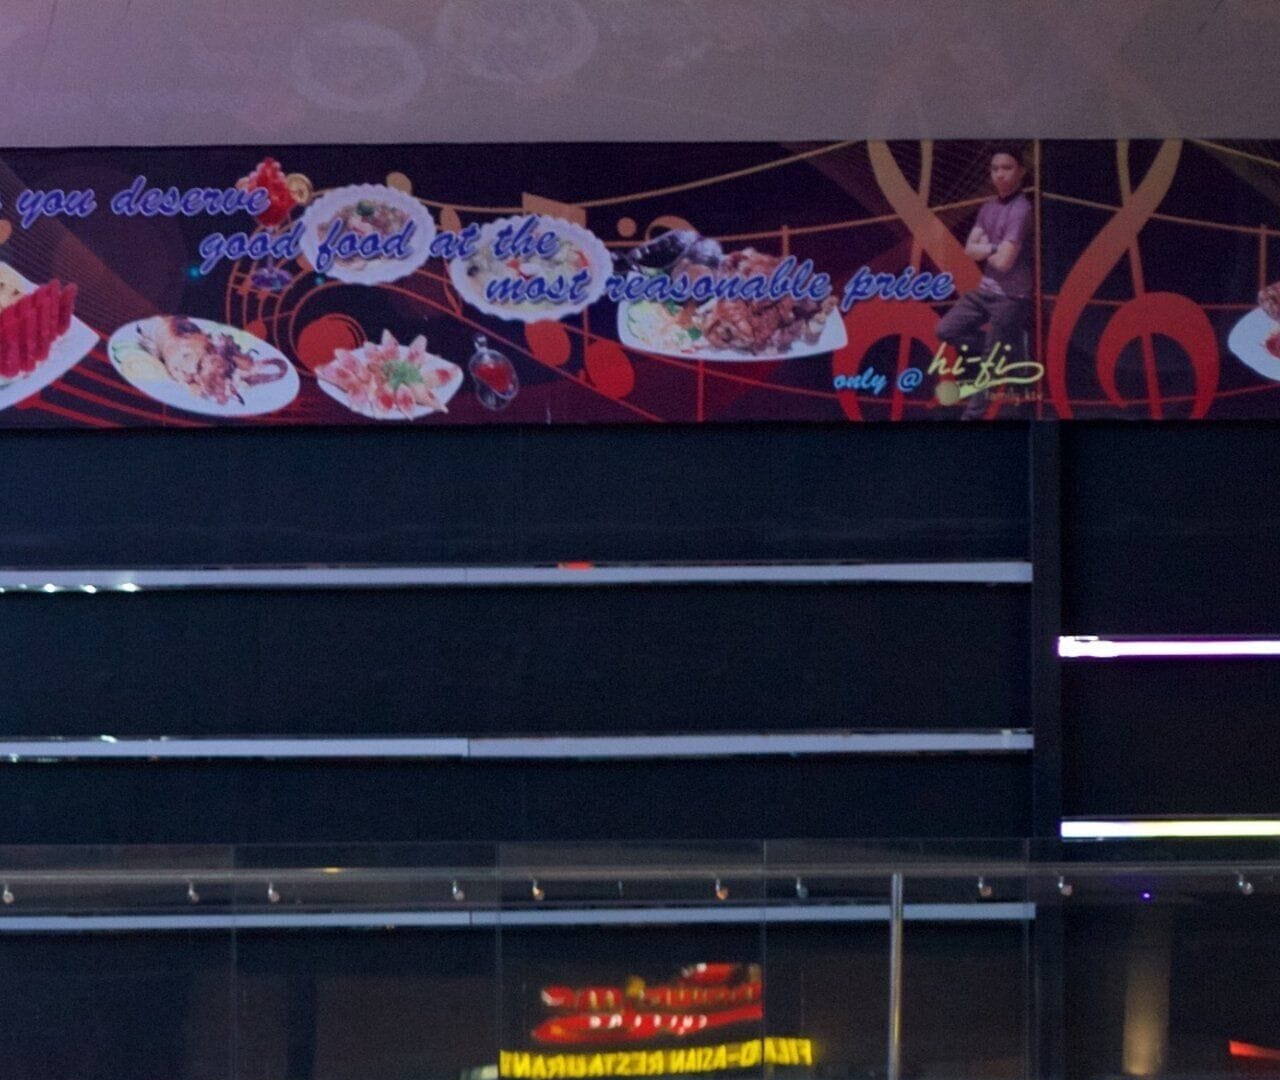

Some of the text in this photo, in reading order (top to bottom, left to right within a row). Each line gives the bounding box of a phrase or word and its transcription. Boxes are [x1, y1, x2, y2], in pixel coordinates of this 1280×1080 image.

[18, 186, 95, 228] you
[110, 174, 271, 218] deserve
[198, 214, 559, 276] good food at the
[485, 254, 953, 312] most reasonable price
[833, 365, 886, 397] only
[899, 367, 924, 392] @
